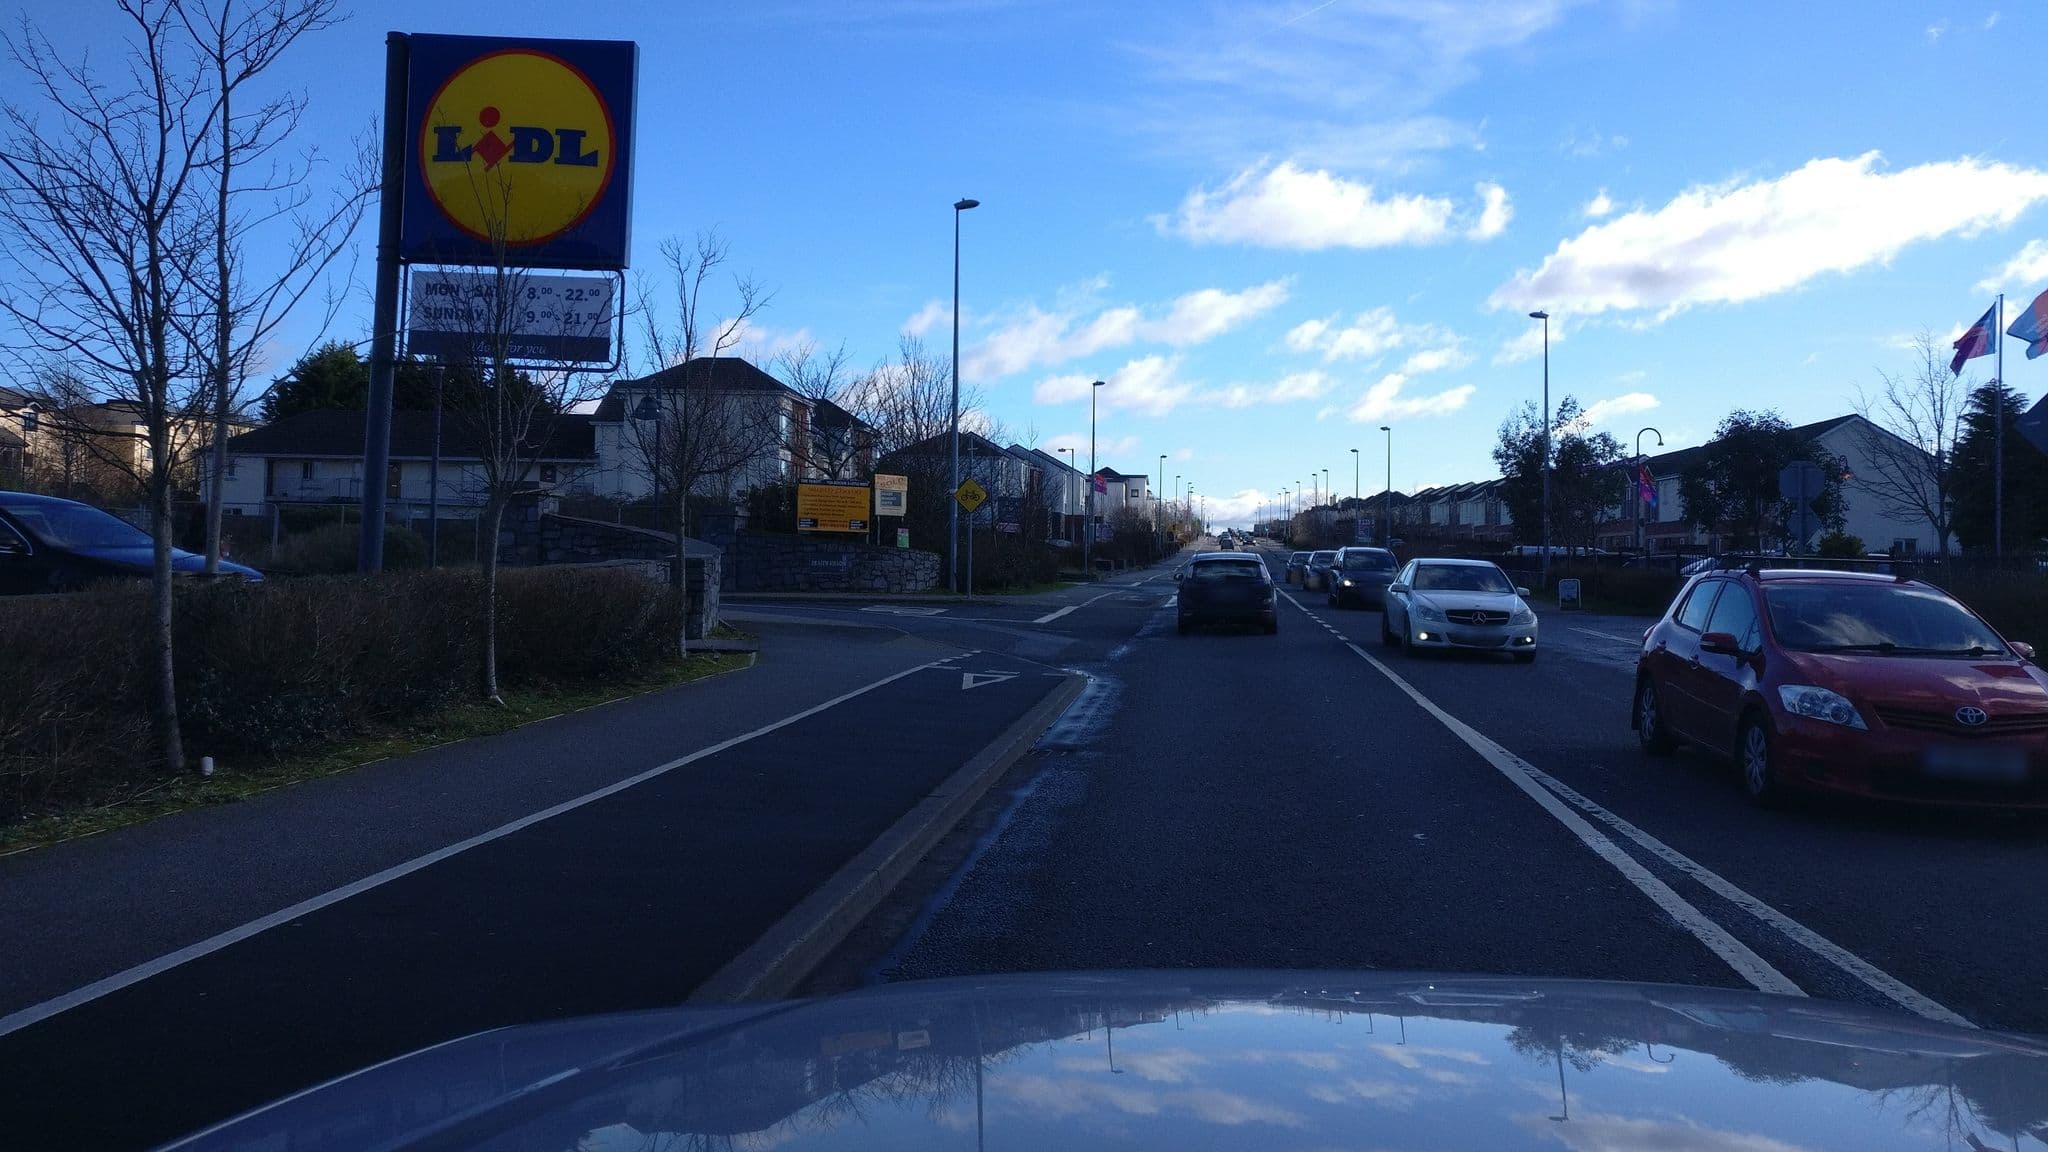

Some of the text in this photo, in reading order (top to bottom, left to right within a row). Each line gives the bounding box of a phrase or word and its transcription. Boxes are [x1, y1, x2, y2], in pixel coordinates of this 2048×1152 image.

[425, 282, 460, 297] MON
[526, 286, 553, 300] 8.00
[565, 288, 601, 302] 22.00
[423, 306, 484, 321] SUNDAY
[526, 310, 552, 324] 9.00
[564, 311, 599, 325] 21.00
[526, 344, 546, 356] you
